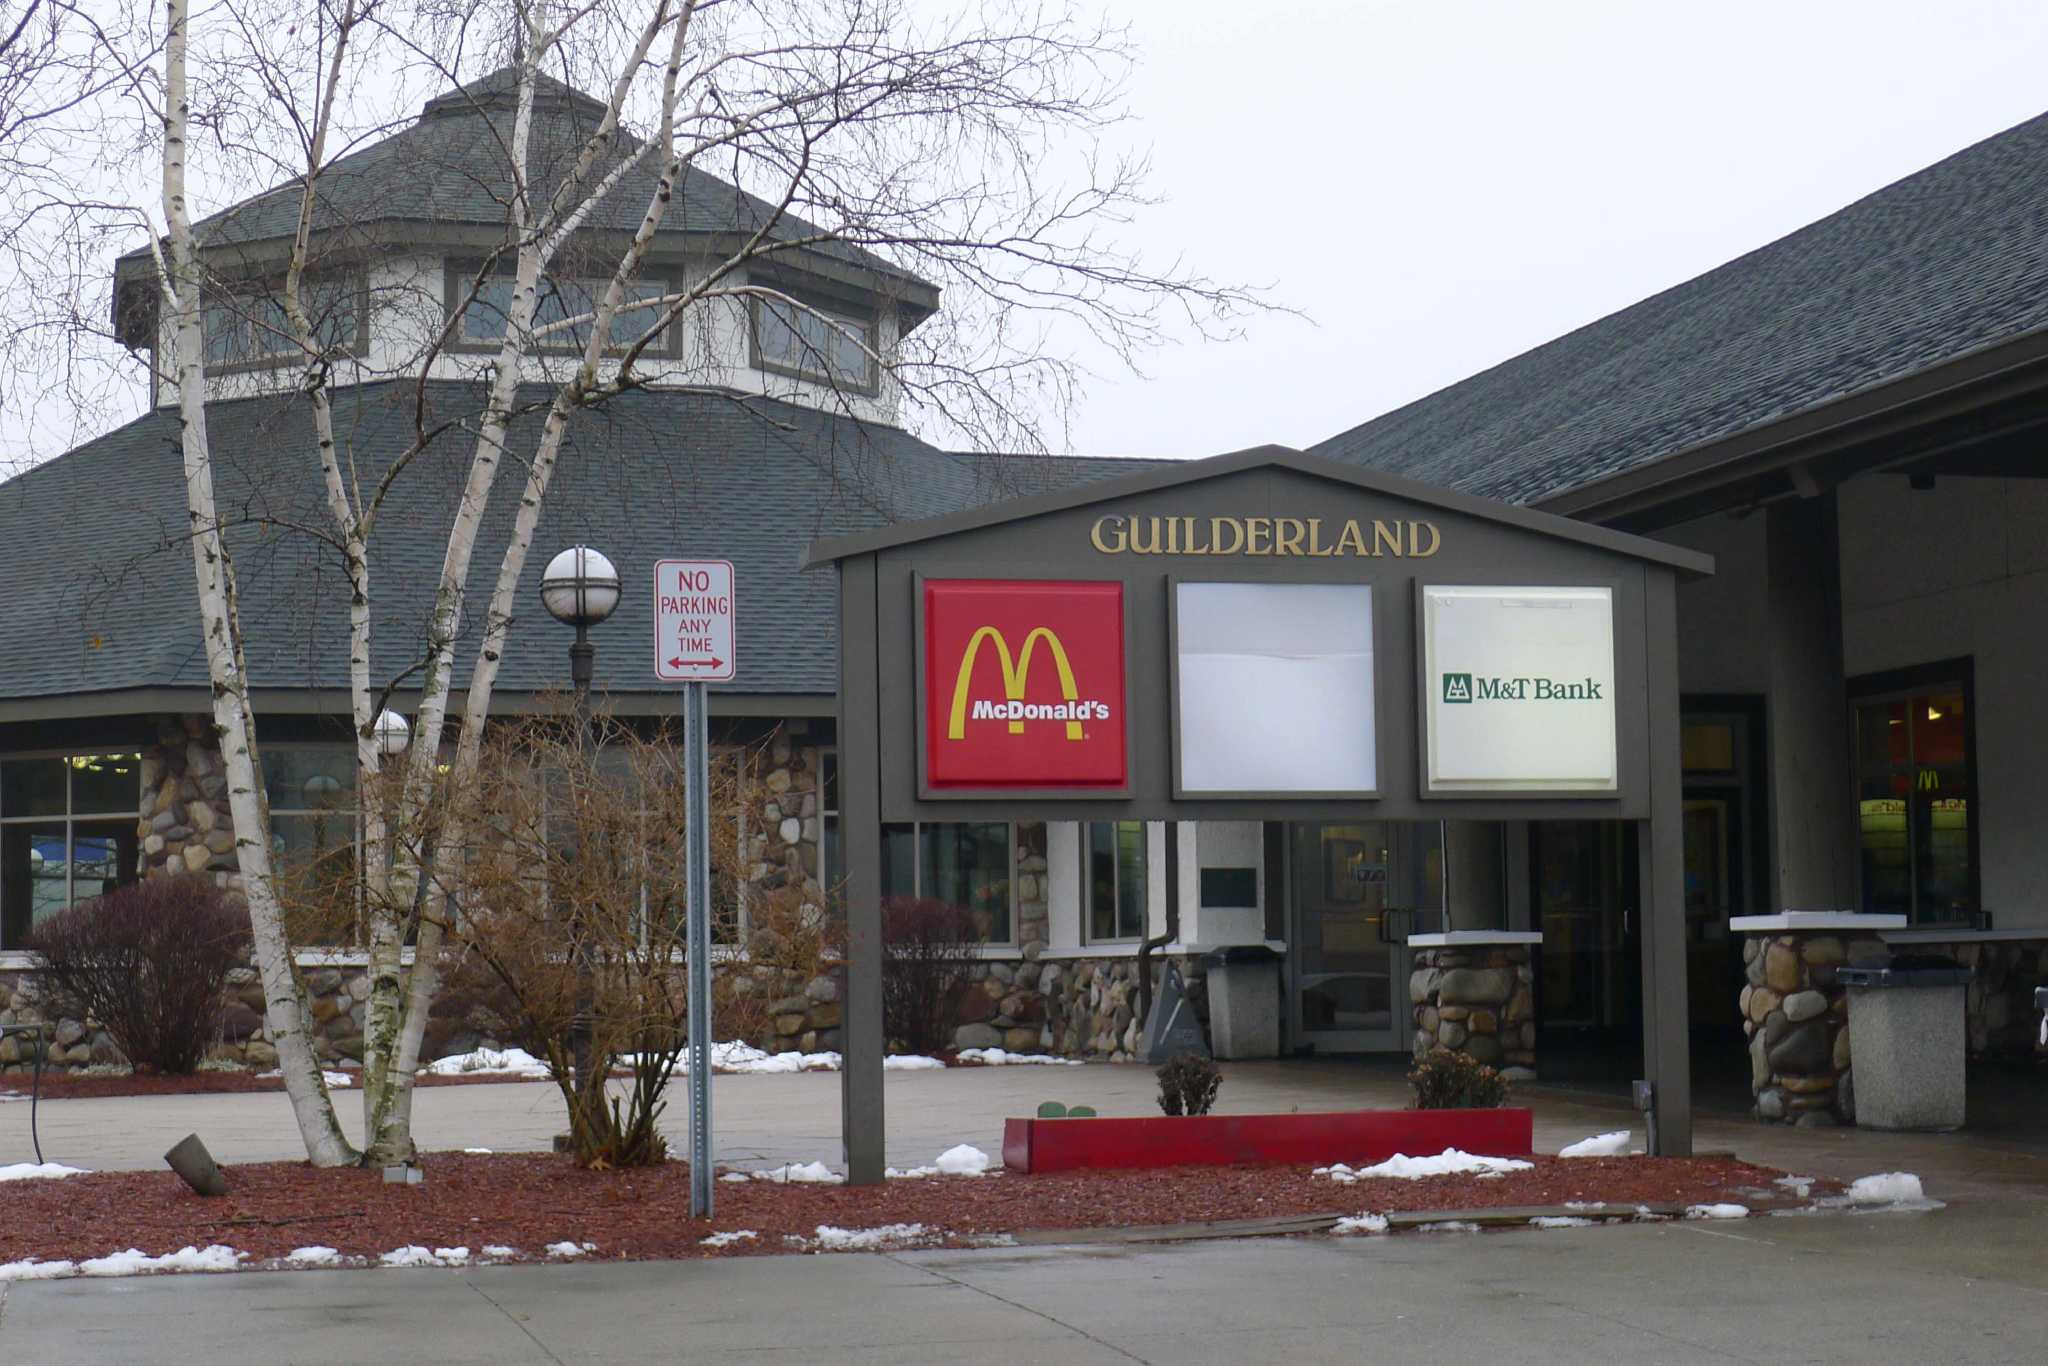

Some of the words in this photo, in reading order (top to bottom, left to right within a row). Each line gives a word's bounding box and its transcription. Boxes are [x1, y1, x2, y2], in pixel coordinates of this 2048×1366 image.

[1090, 514, 1441, 558] GUILDERLAND
[678, 570, 710, 592] NO
[661, 596, 728, 615] PARKING
[678, 619, 712, 633] ANY
[678, 637, 713, 652] TIME
[1476, 677, 1530, 700] M&T
[1534, 677, 1602, 700] Bank
[972, 700, 1109, 720] McDonald's
